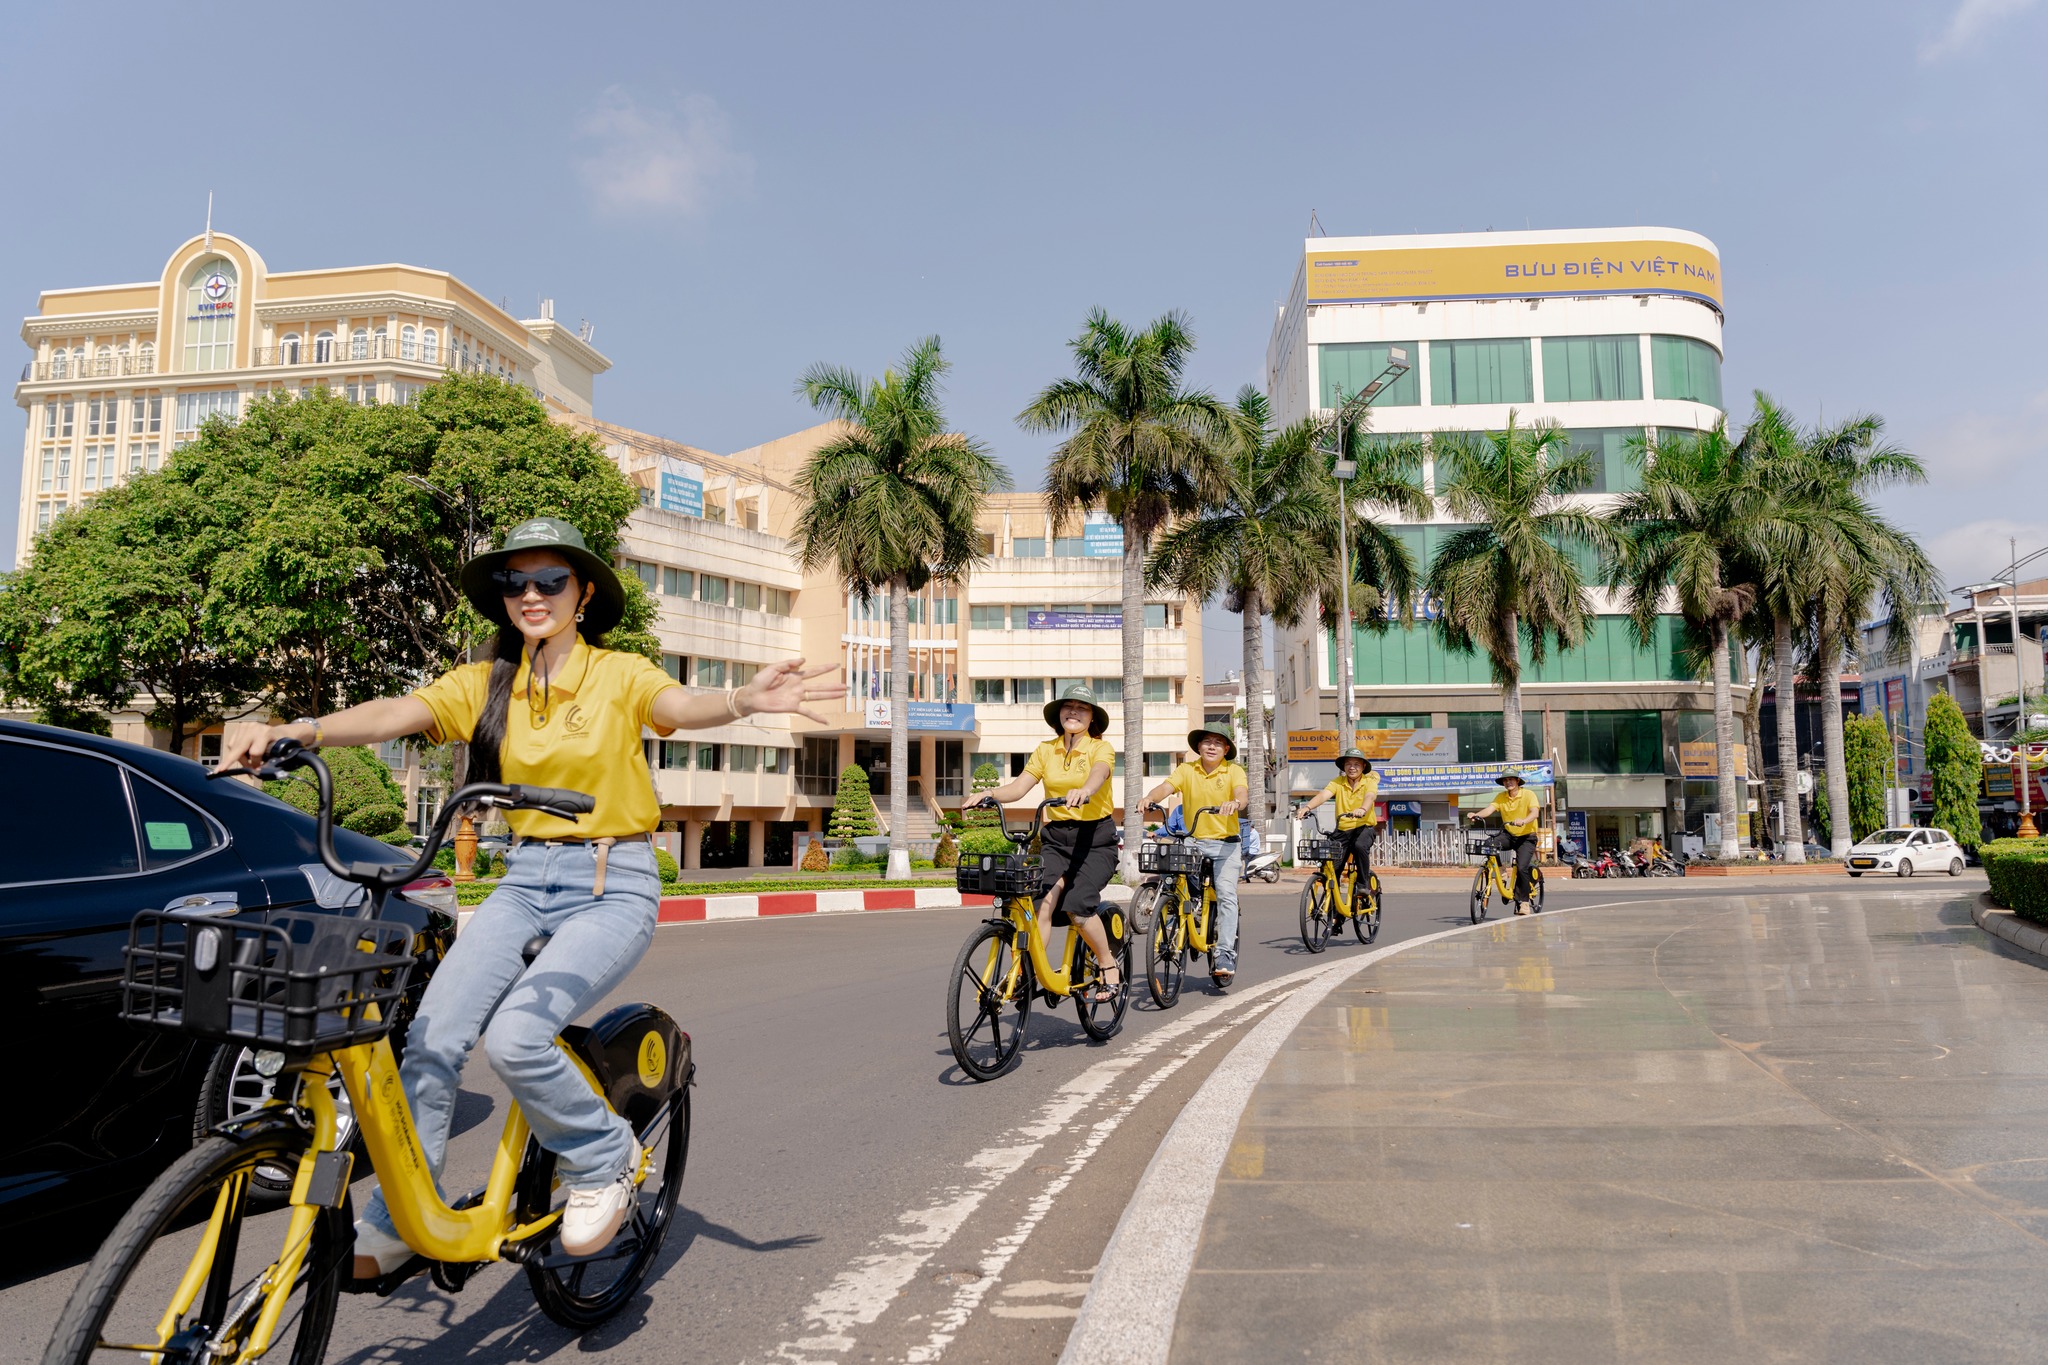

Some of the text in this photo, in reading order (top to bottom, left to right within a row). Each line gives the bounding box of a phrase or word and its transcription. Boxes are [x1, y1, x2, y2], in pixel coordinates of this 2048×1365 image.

[1505, 256, 1715, 284] BƯU ĐIỆN VIỆT NAM
